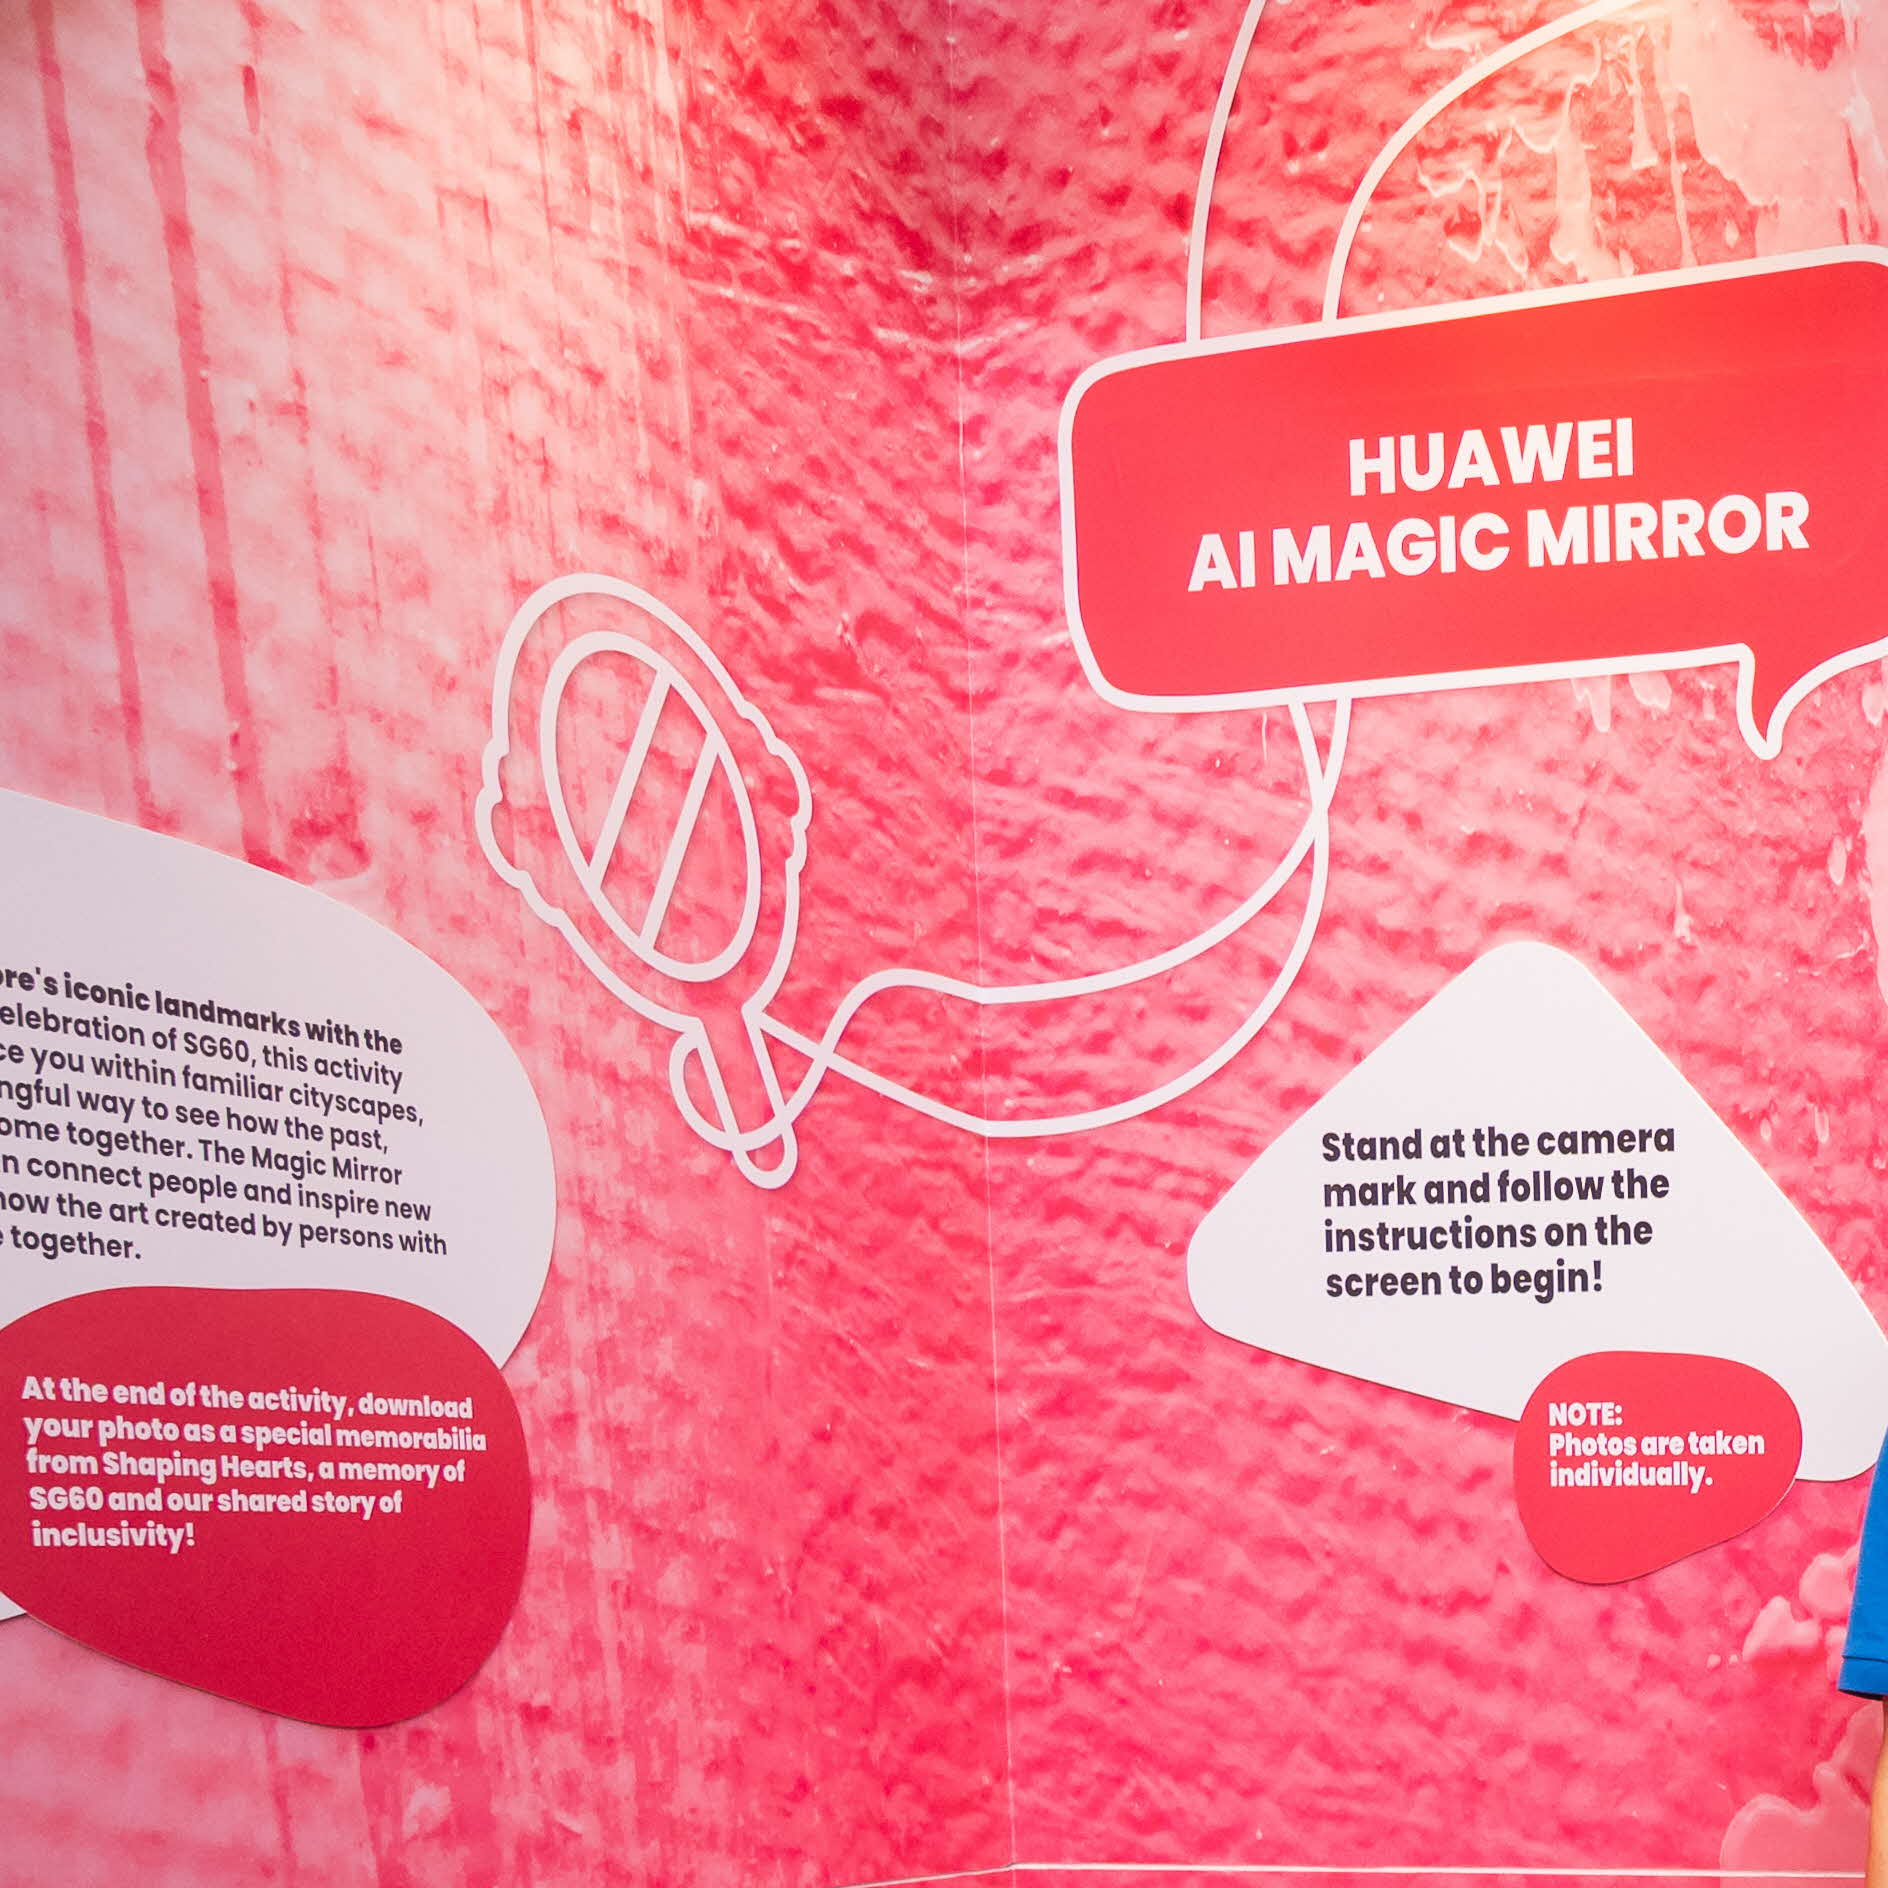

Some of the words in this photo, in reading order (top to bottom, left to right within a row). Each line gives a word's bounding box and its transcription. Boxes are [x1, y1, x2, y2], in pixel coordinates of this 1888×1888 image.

[1350, 418, 1633, 496] HUAWEI
[1188, 531, 1255, 591] AI
[1273, 513, 1509, 585] MAGIC
[1527, 492, 1809, 567] MIRROR
[0, 967, 58, 995] re's
[64, 972, 150, 1011] iconic
[155, 991, 300, 1037] landmarks
[305, 1019, 359, 1048] with
[364, 1029, 402, 1054] the
[0, 1003, 145, 1046] elebration
[152, 1028, 176, 1051] of
[184, 1032, 256, 1067] SG60,
[263, 1046, 307, 1072] this
[315, 1058, 402, 1093] activity
[31, 1048, 84, 1074] you
[91, 1053, 176, 1086] within
[183, 1065, 283, 1102] familiar
[290, 1083, 423, 1126] cityscapes,
[0, 1080, 70, 1110] ngful
[77, 1091, 135, 1123] way
[142, 1096, 168, 1120] to
[176, 1106, 219, 1127] see
[227, 1107, 278, 1135] how
[285, 1117, 323, 1141] the
[331, 1127, 387, 1154] past,
[67, 1122, 192, 1159] together.
[198, 1139, 244, 1165] The
[252, 1146, 326, 1180] Magic
[332, 1155, 402, 1186] Mirror
[1323, 1129, 1422, 1161] Stand
[1431, 1129, 1465, 1158] at
[1473, 1127, 1529, 1157] the
[1537, 1128, 1674, 1155] camera
[27, 1158, 142, 1188] connect
[149, 1172, 237, 1203] people
[244, 1183, 291, 1205] and
[298, 1183, 378, 1218] inspire
[386, 1201, 431, 1221] new
[1324, 1175, 1416, 1207] mark
[1424, 1172, 1490, 1204] and
[1498, 1170, 1604, 1202] follow
[1612, 1168, 1669, 1199] the
[11, 1226, 140, 1259] together.
[56, 1193, 102, 1219] the
[110, 1203, 148, 1224] art
[156, 1209, 256, 1235] created
[263, 1215, 292, 1246] by
[300, 1224, 393, 1249] persons
[399, 1230, 446, 1255] with
[1325, 1215, 1536, 1252] instructions
[1545, 1223, 1587, 1246] on
[1595, 1215, 1652, 1245] the
[1327, 1272, 1441, 1297] screen
[1449, 1266, 1483, 1294] to
[1491, 1258, 1601, 1304] begin!
[22, 1376, 55, 1400] At
[60, 1378, 108, 1402] the
[113, 1382, 165, 1405] end
[170, 1384, 196, 1406] of
[200, 1385, 244, 1408] the
[248, 1388, 354, 1420] activity,
[359, 1393, 472, 1418] download
[1549, 1402, 1622, 1426] NOTE:
[24, 1417, 93, 1444] your
[99, 1417, 179, 1447] photo
[184, 1424, 215, 1442] as
[220, 1425, 236, 1442] a
[241, 1423, 331, 1451] special
[336, 1428, 486, 1450] memorabilia
[1550, 1432, 1637, 1456] Photos
[1641, 1436, 1684, 1455] are
[1688, 1431, 1764, 1455] taken
[26, 1451, 98, 1474] from
[103, 1452, 216, 1485] Shaping
[221, 1455, 314, 1482] Hearts,
[319, 1462, 334, 1479] a
[339, 1463, 440, 1488] memory
[443, 1459, 465, 1481] of
[1550, 1461, 1712, 1493] individually.
[30, 1486, 103, 1510] SG60
[109, 1488, 162, 1511] and
[167, 1493, 213, 1511] our
[218, 1489, 307, 1512] shared
[312, 1491, 375, 1520] story
[380, 1490, 402, 1513] of
[32, 1520, 194, 1554] inclusivity!
